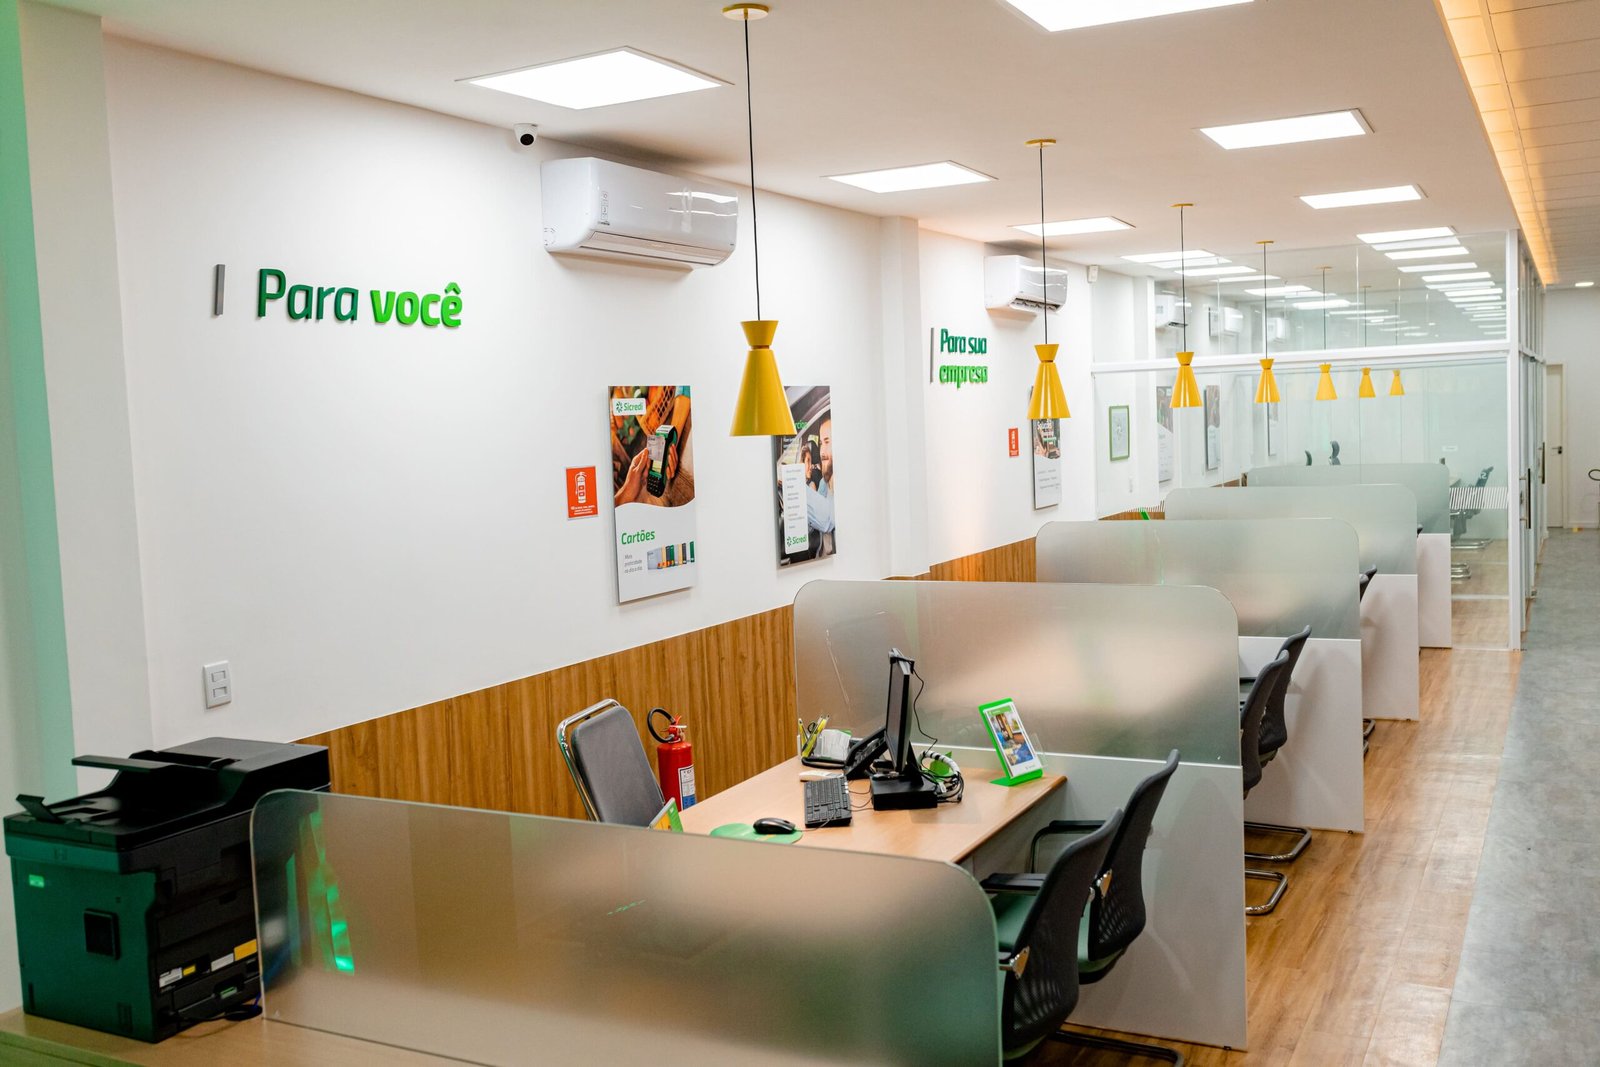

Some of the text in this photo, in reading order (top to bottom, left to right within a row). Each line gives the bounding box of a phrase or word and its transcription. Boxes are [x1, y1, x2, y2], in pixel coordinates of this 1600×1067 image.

[257, 268, 463, 327] Para você
[940, 328, 987, 354] Para sua
[939, 365, 988, 389] empresa
[623, 402, 644, 412] Sicredi
[621, 529, 655, 545] Cartões
